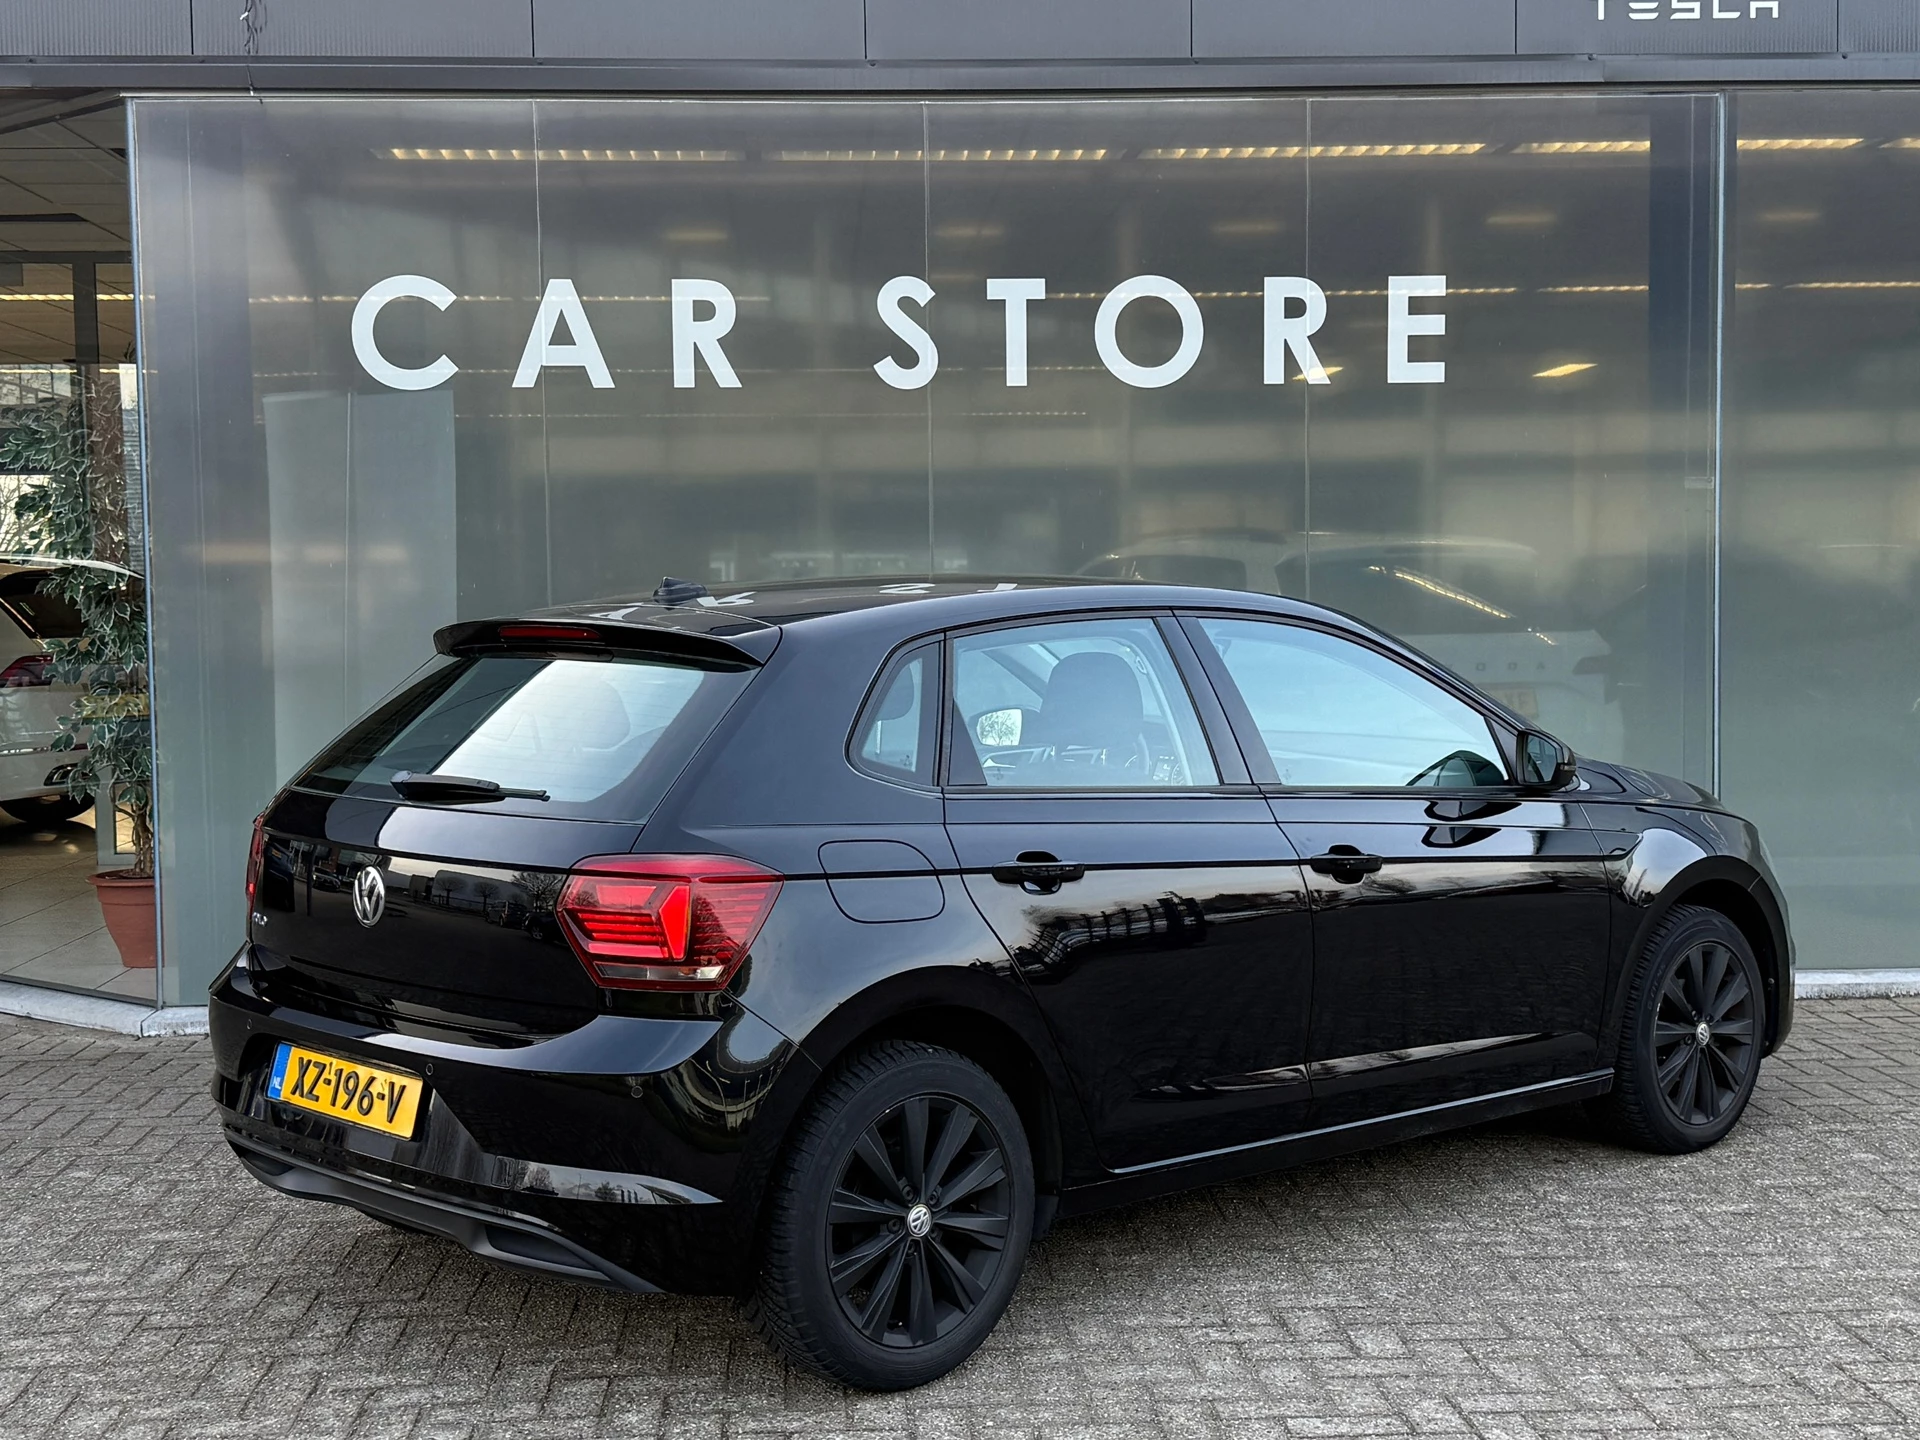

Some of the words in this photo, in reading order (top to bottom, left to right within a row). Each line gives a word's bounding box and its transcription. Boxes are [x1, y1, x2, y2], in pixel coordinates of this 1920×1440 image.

[351, 274, 743, 390] CAR
[873, 274, 1446, 389] STORE
[290, 1056, 407, 1124] XZ-196-V
